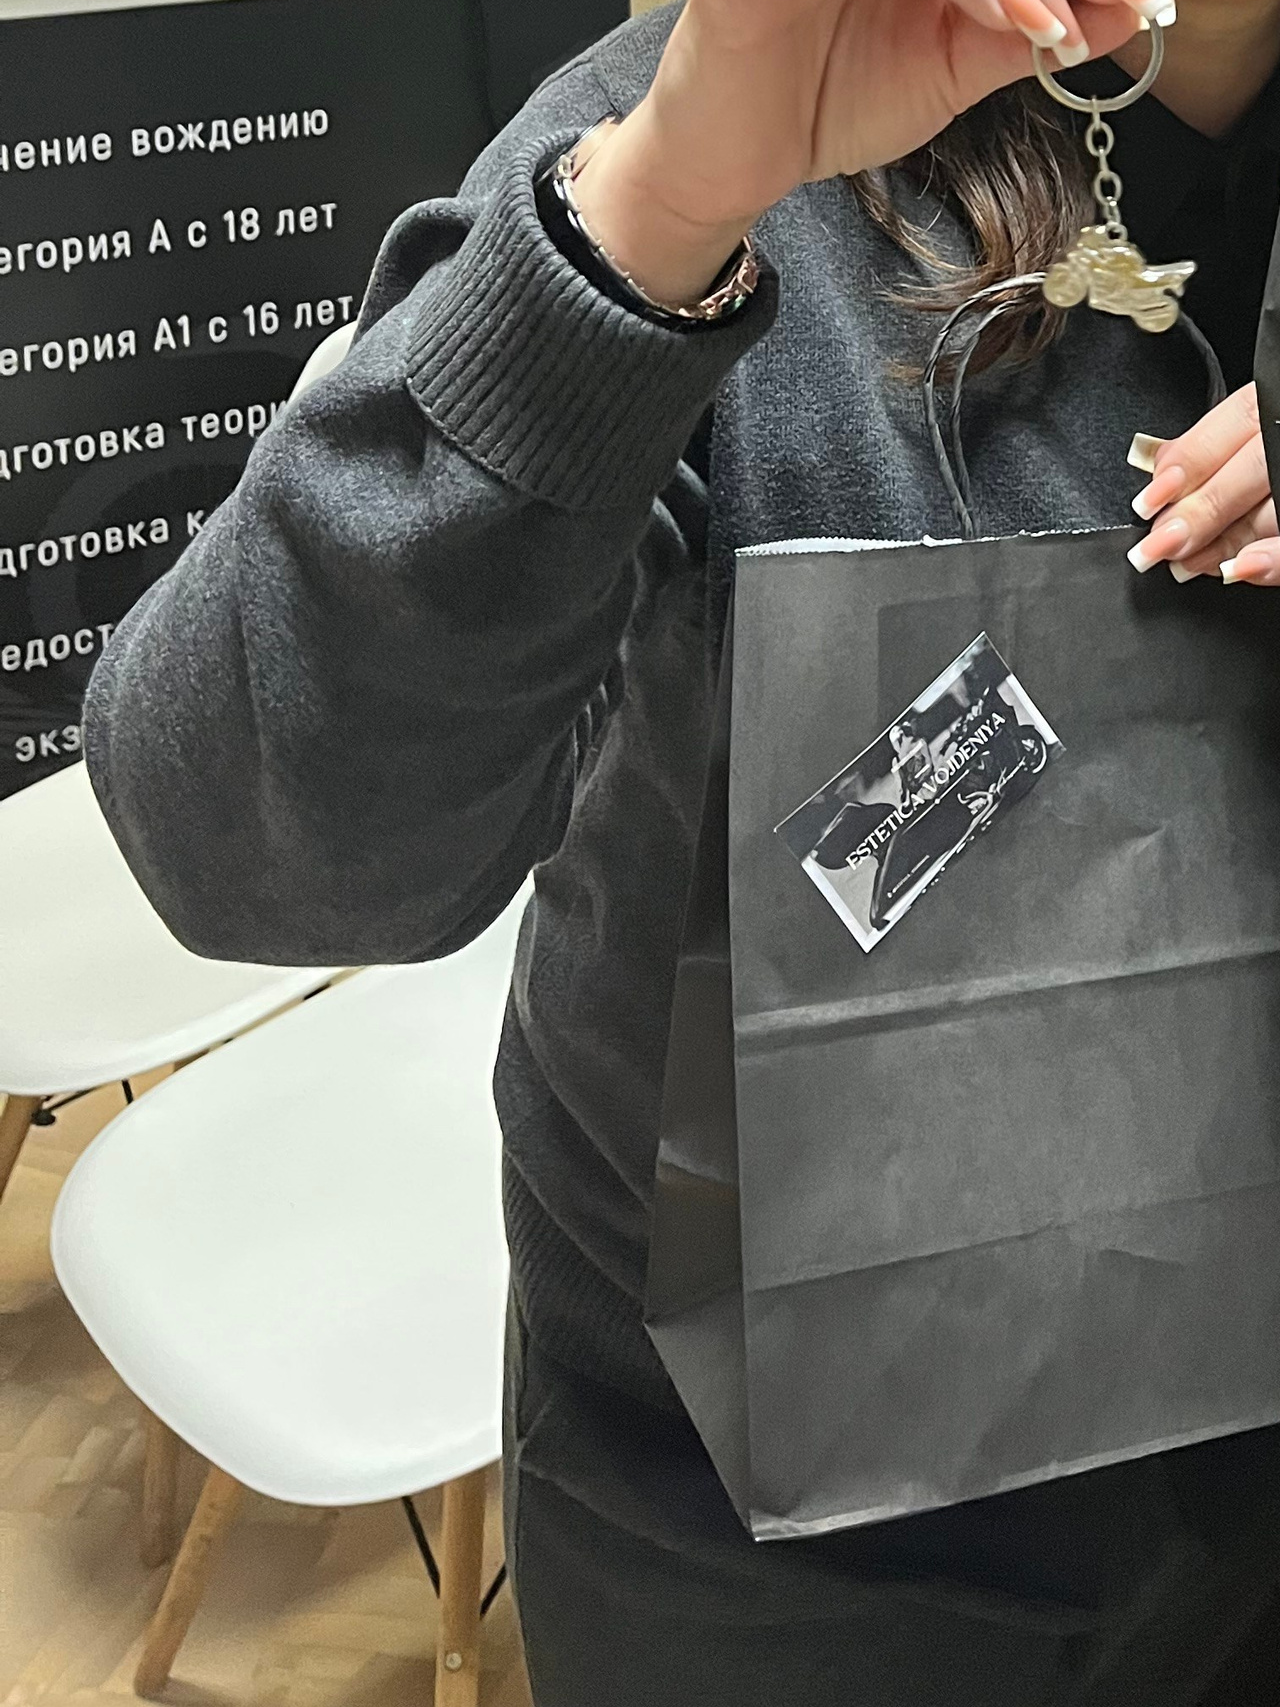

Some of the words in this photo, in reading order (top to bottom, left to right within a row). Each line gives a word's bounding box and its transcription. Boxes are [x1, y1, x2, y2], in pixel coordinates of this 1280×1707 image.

[131, 109, 328, 157] вождению
[0, 230, 131, 274] егория
[149, 219, 171, 254] А
[187, 220, 207, 248] с
[223, 207, 260, 243] 18
[275, 202, 337, 236] лет
[0, 330, 136, 376] егория
[154, 314, 190, 352] А1
[208, 315, 227, 343] с
[243, 301, 279, 336] 16
[294, 295, 353, 329] лет
[0, 517, 169, 577] дготовка
[1, 623, 114, 671] едост
[15, 725, 81, 762] экз
[845, 793, 926, 871] ESTETICA
[922, 712, 1006, 793] VOJDENIYA
